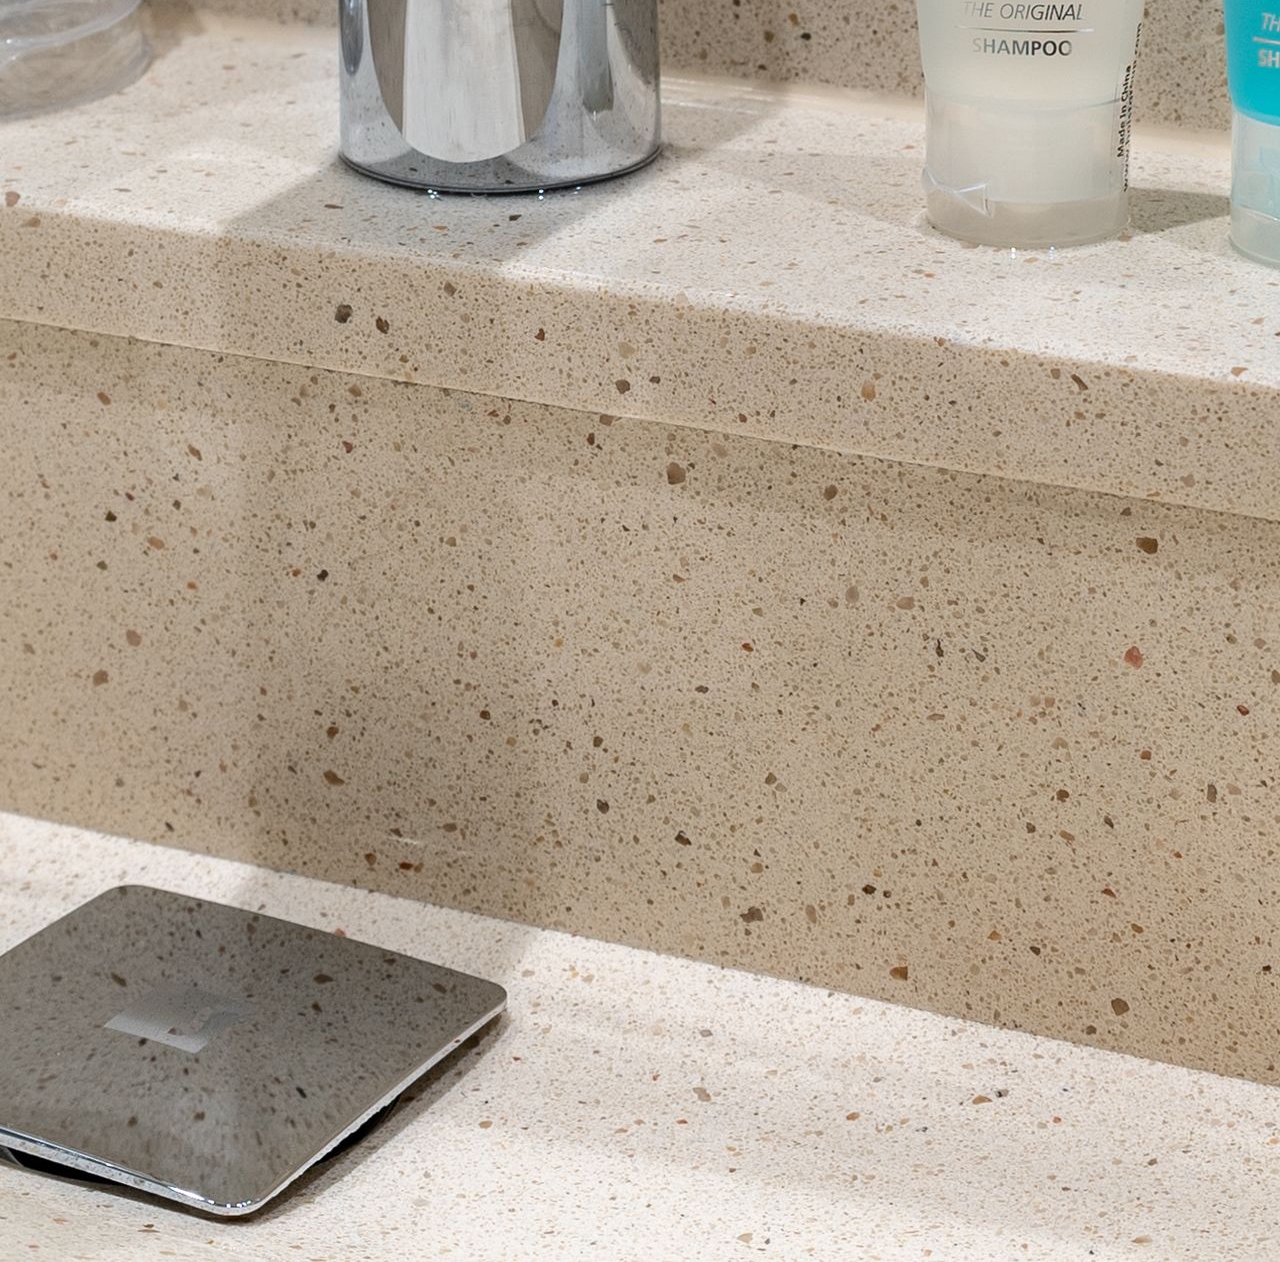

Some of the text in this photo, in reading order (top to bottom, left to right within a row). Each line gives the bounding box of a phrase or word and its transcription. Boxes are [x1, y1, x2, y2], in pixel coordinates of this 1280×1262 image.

[963, 1, 1084, 21] THE ORIGINAL
[972, 37, 1073, 57] SHAMPOO
